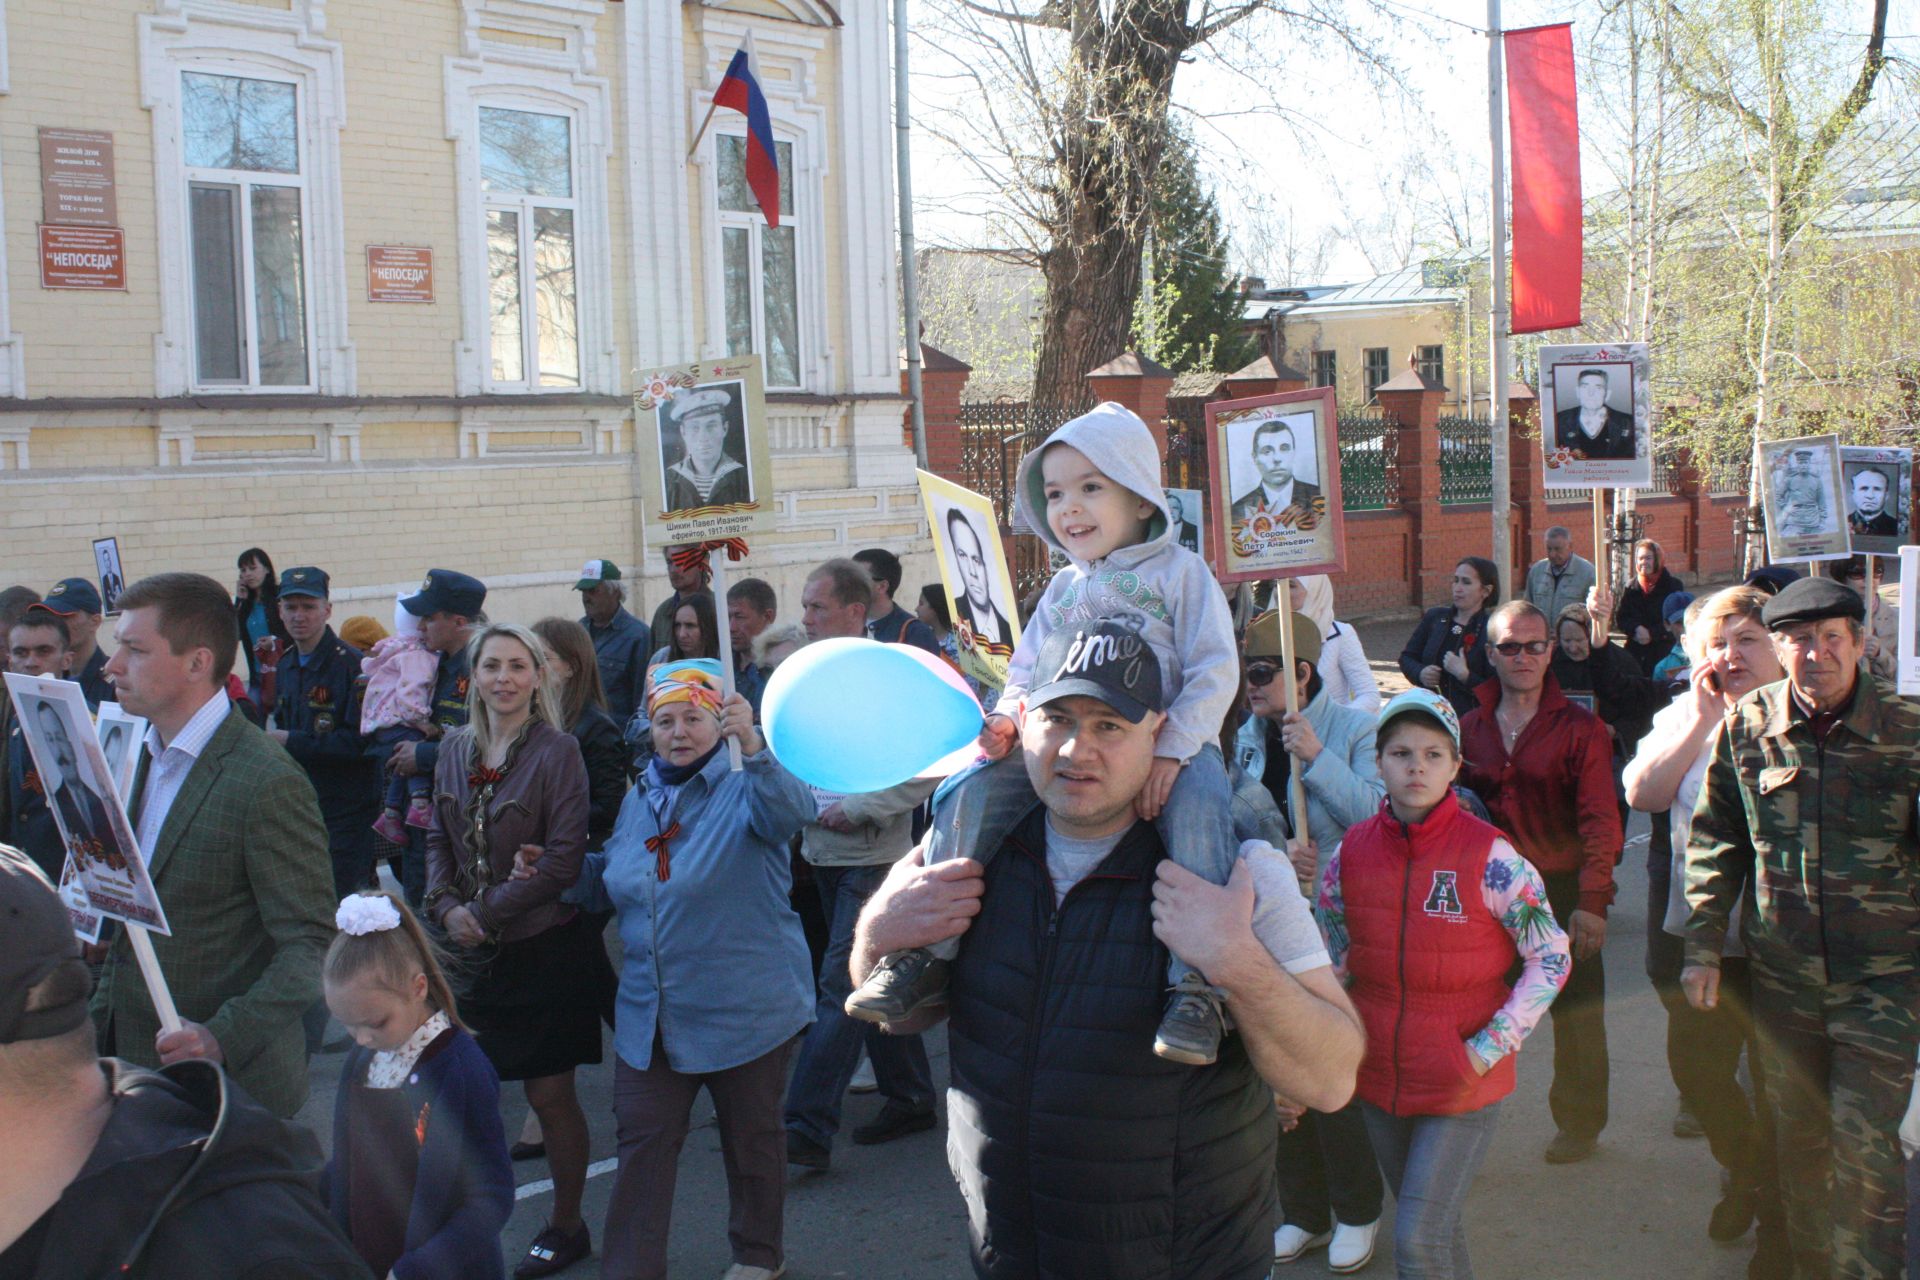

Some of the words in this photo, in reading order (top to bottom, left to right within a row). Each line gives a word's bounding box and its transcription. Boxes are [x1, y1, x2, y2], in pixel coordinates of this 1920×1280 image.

[666, 522, 691, 531] Шикин
[693, 518, 716, 528] Павел
[716, 515, 755, 525] Иванович
[708, 524, 740, 535] 1917-1992
[1260, 529, 1297, 539] Сорокин
[1243, 543, 1265, 552] Петр
[1267, 537, 1315, 548] Ананьевич
[1424, 870, 1462, 914] A
